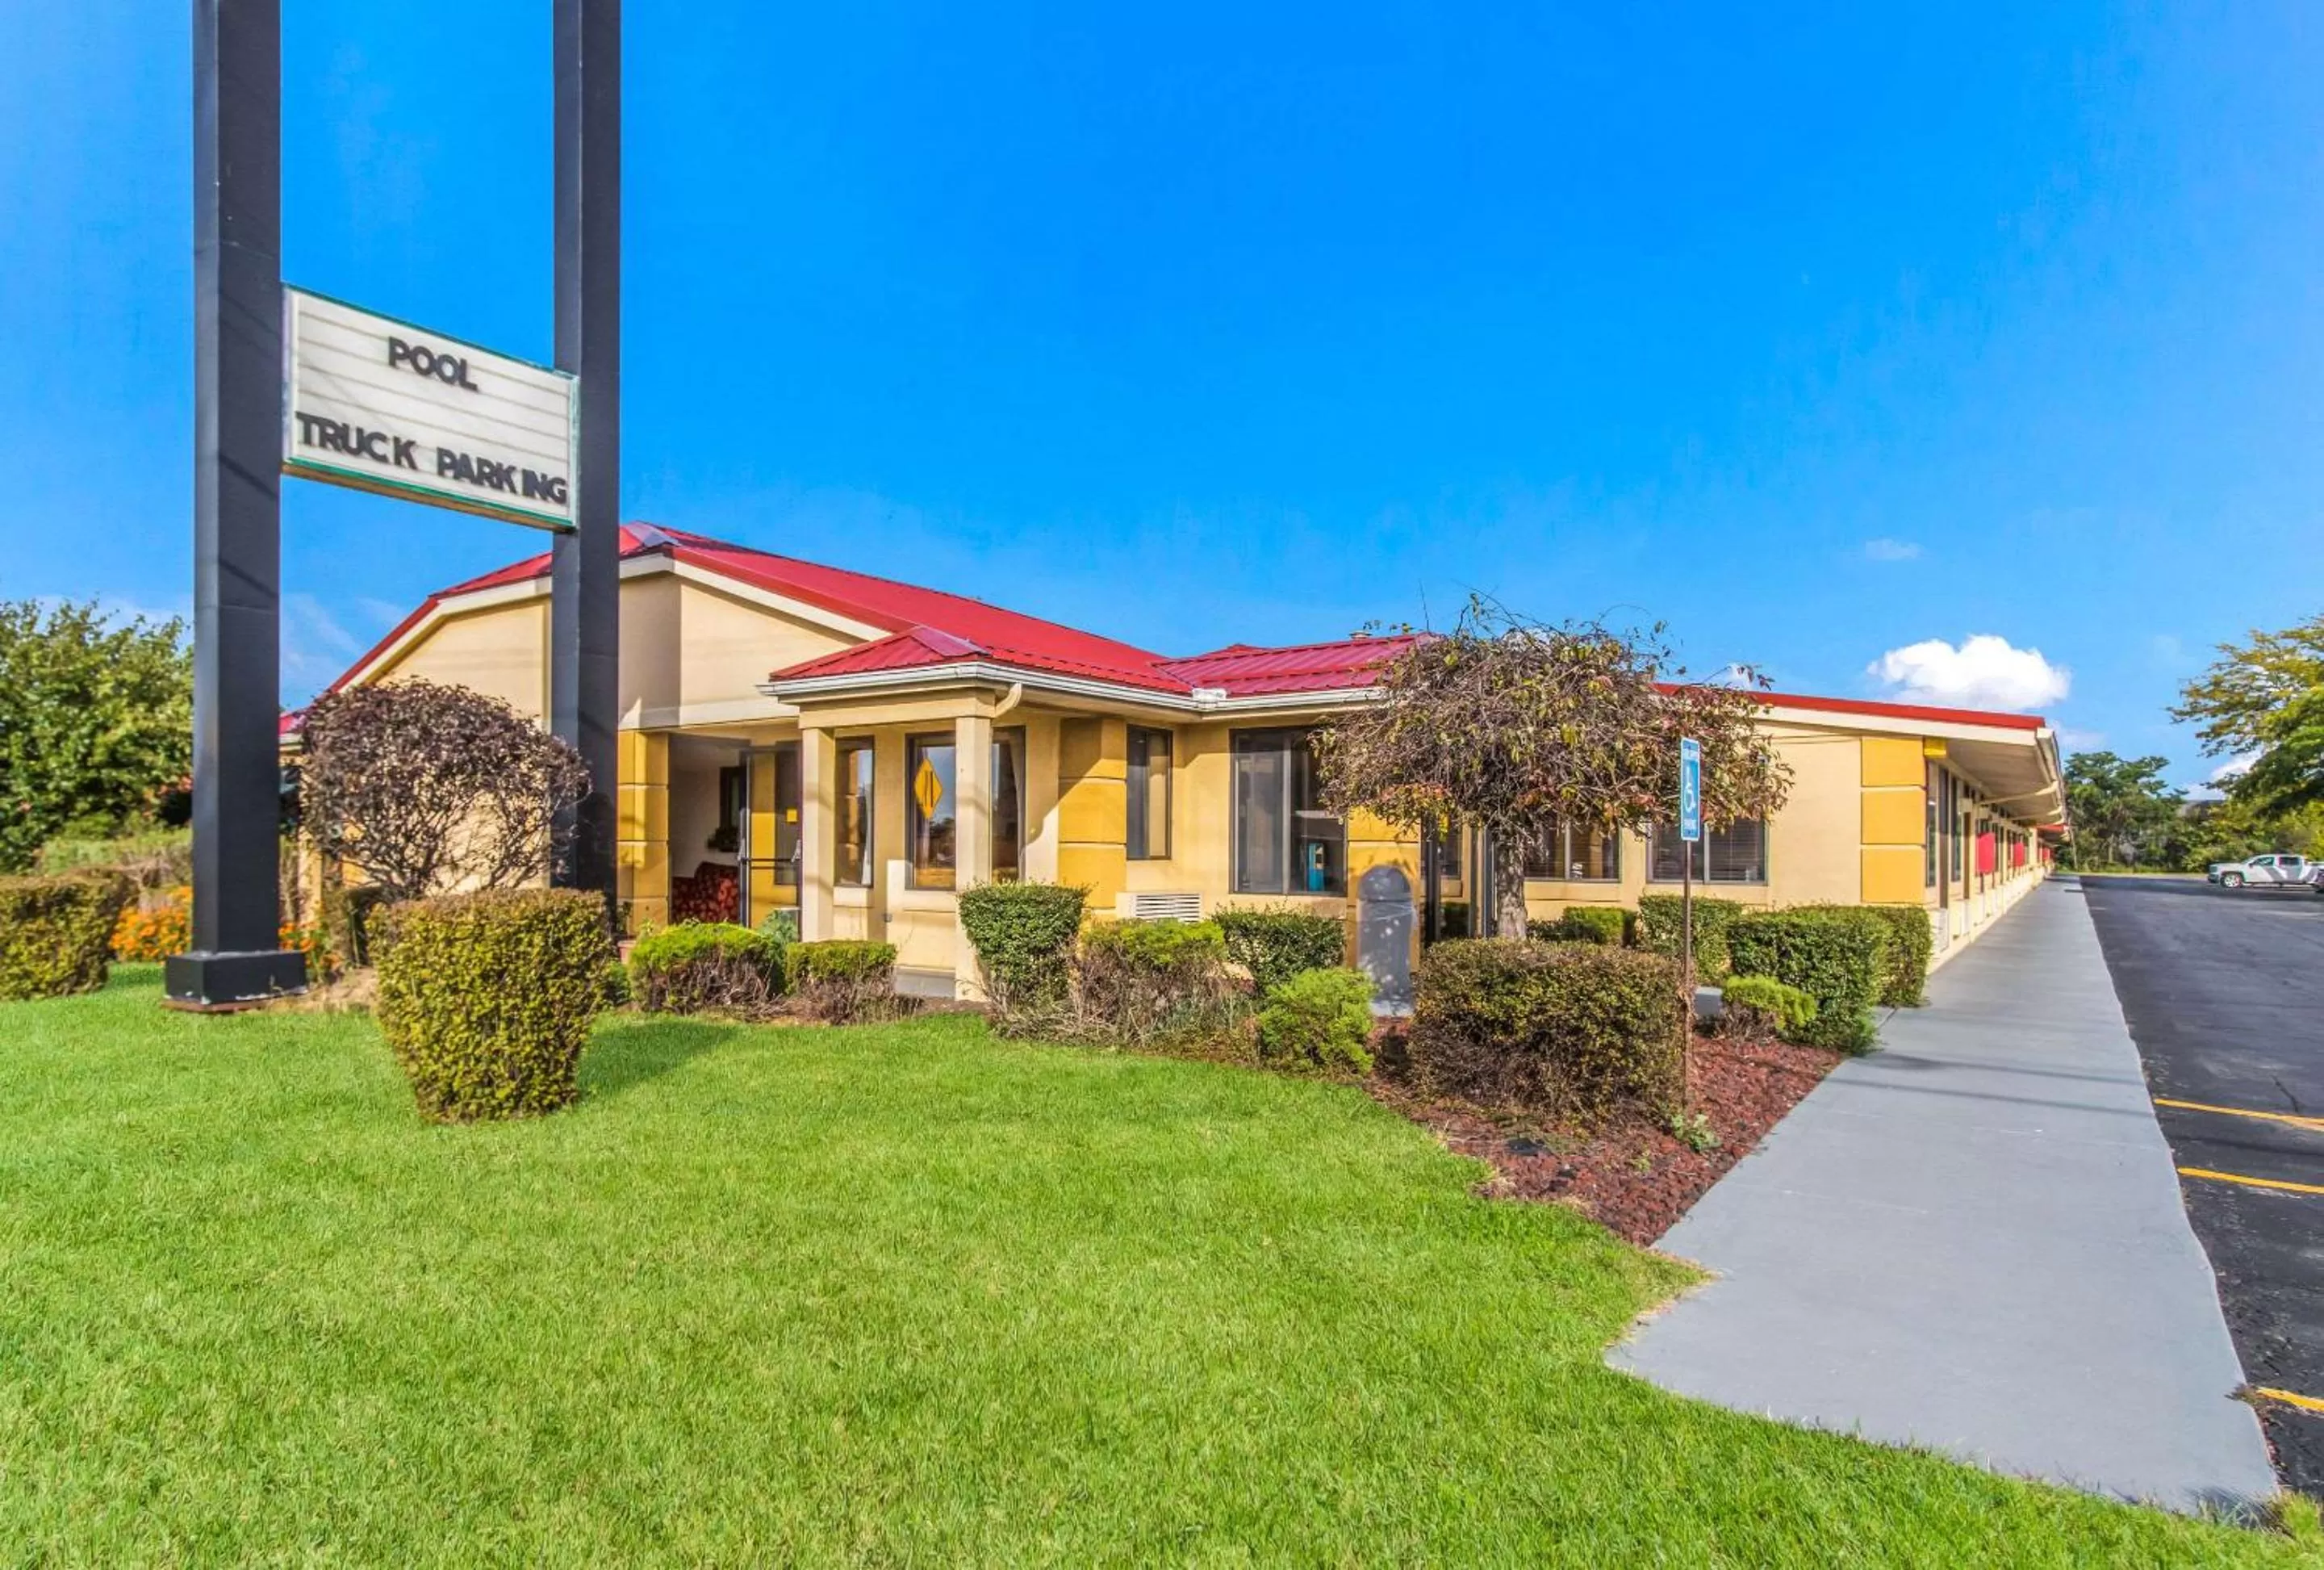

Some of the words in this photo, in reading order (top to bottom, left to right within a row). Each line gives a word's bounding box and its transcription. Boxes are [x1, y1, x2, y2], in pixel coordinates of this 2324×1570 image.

[388, 336, 479, 391] POOL
[295, 411, 417, 470] TRUCK
[437, 446, 567, 504] PARKING
